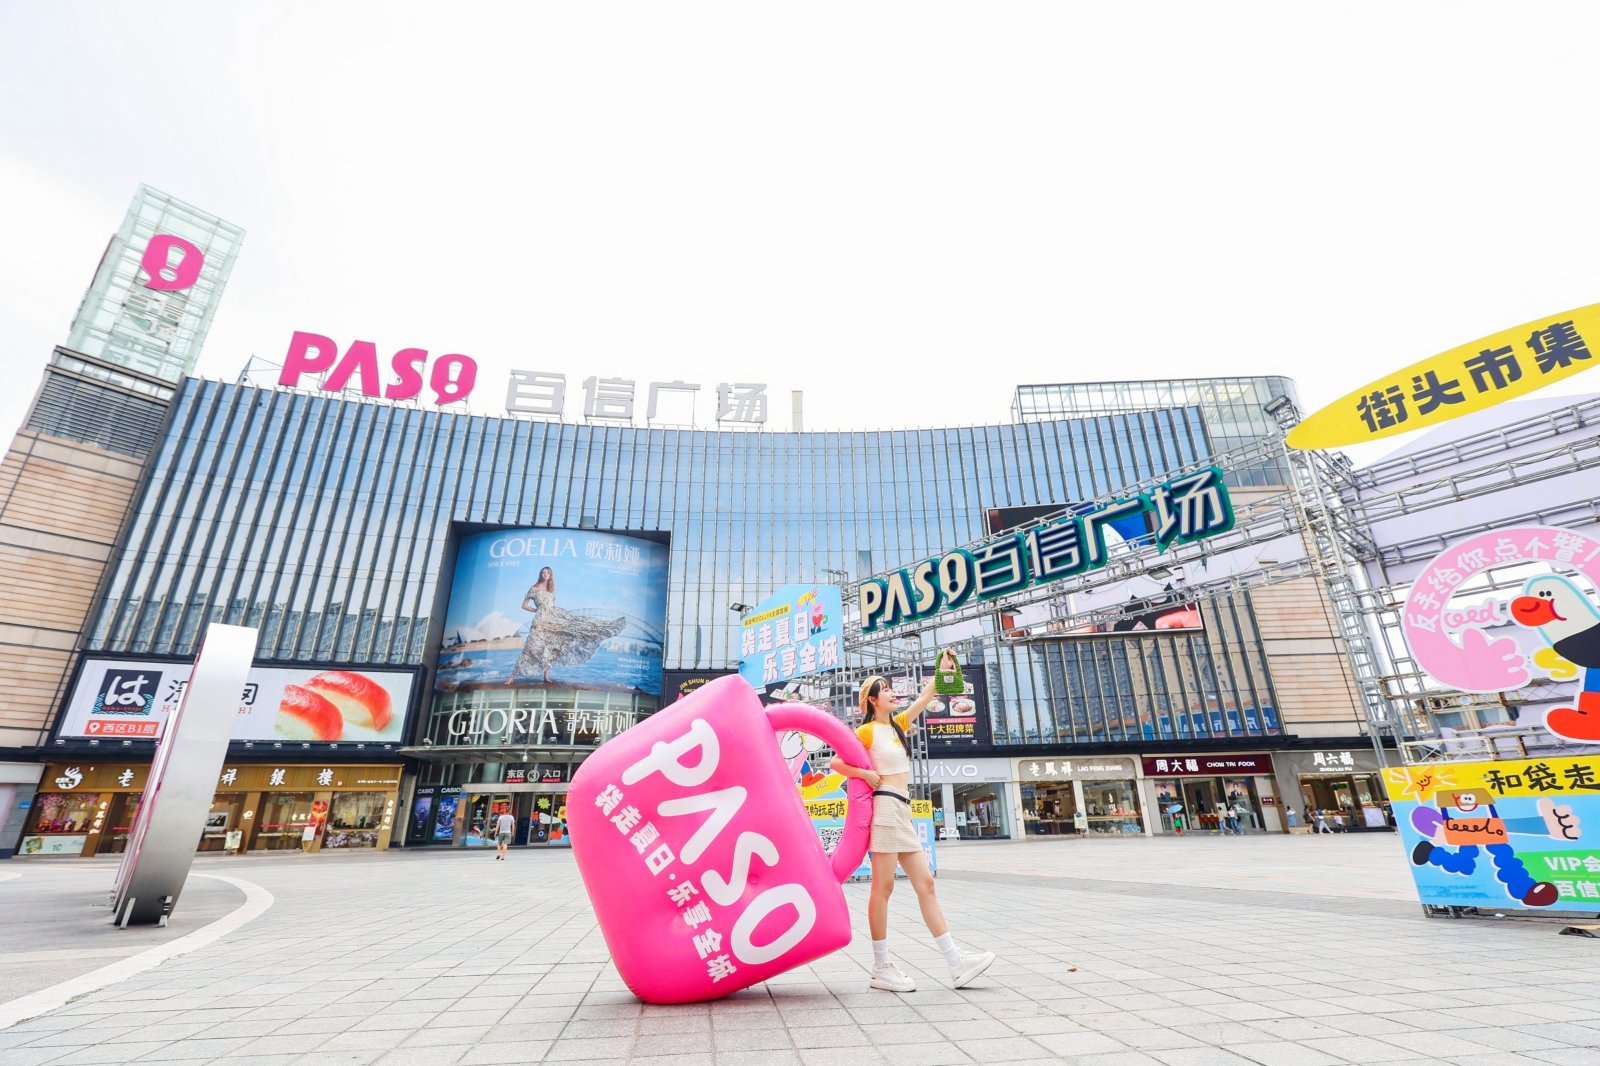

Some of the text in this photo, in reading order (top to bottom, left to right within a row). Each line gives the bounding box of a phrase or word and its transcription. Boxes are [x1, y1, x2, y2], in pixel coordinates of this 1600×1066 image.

[278, 330, 768, 423] PASO 百信广场
[1356, 320, 1593, 433] 街头市集
[489, 538, 577, 558] GOELIA
[859, 468, 1226, 630] PASO 百信广场
[741, 610, 810, 658] 袋走夏日
[763, 634, 840, 683] 乐享全城
[102, 723, 157, 733] 西区B1层
[448, 709, 560, 736] GLORIA
[927, 723, 975, 735] 十大招牌菜
[922, 761, 978, 777] vivo
[1156, 759, 1199, 772] 周大福
[1313, 752, 1354, 766] 周六福
[507, 769, 525, 778] 东区
[543, 769, 561, 778] 入口
[1486, 761, 1600, 795] 和袋走
[622, 718, 817, 965] PASO
